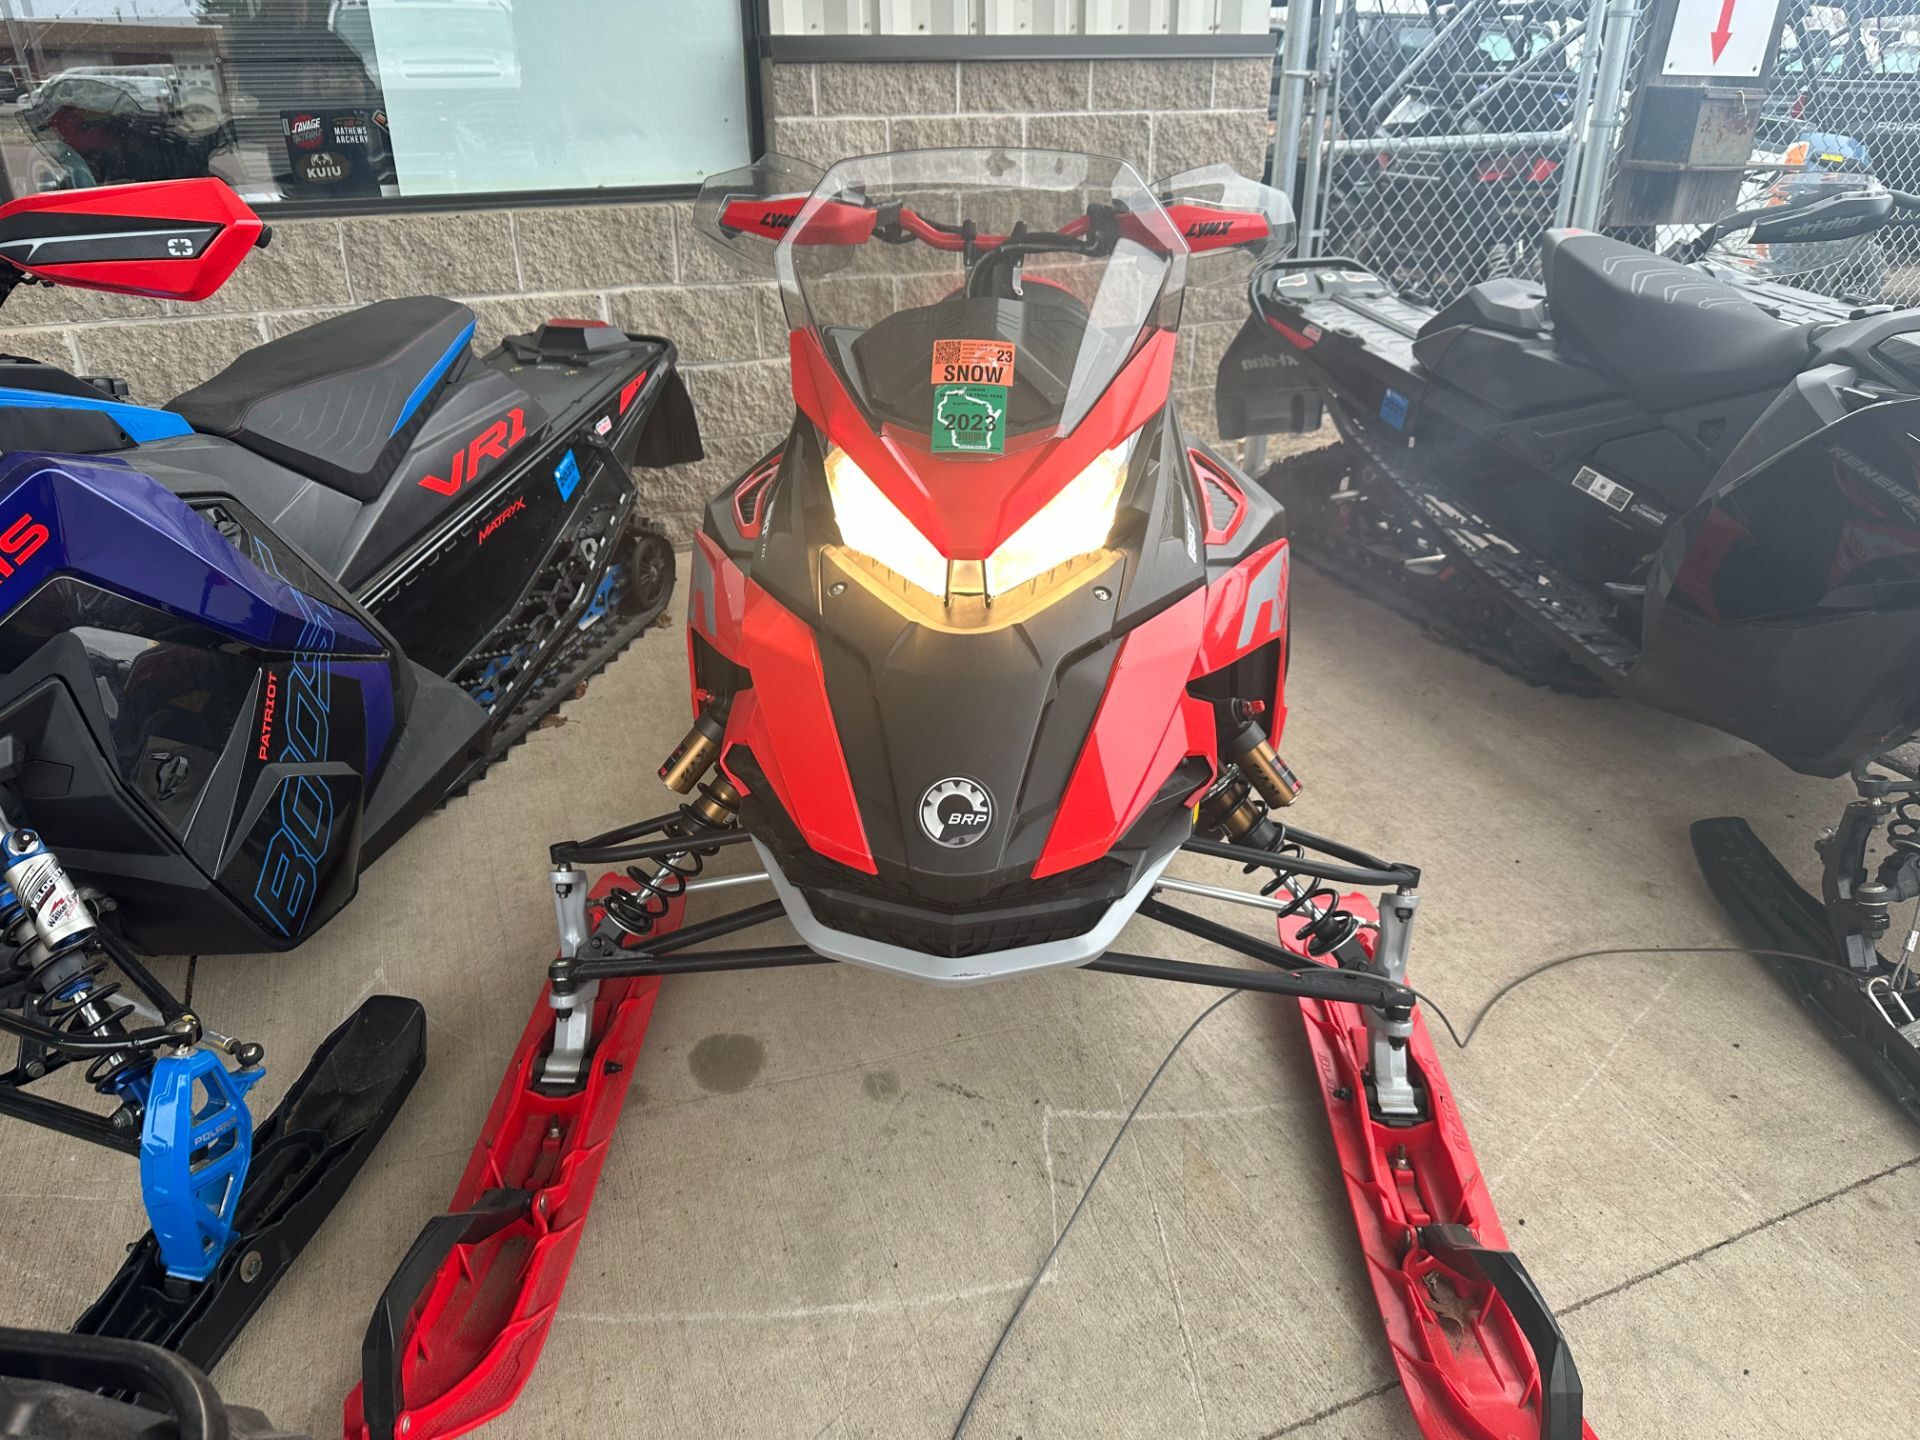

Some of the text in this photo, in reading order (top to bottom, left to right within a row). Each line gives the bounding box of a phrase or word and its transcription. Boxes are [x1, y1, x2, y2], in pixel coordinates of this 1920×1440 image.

[292, 118, 320, 133] SAVAGE
[334, 127, 367, 135] MATHEWS
[336, 135, 368, 144] ARCHERY
[307, 166, 341, 179] KUIU
[1185, 221, 1233, 237] LYNX
[1784, 215, 1865, 238] ski-doo
[997, 350, 1012, 362] 23
[944, 365, 1004, 383] SNOW
[944, 413, 997, 432] 2023
[417, 407, 526, 497] VR1
[478, 497, 526, 546] MATRYX
[258, 671, 278, 761] PATRIOT
[948, 812, 987, 825] BRP
